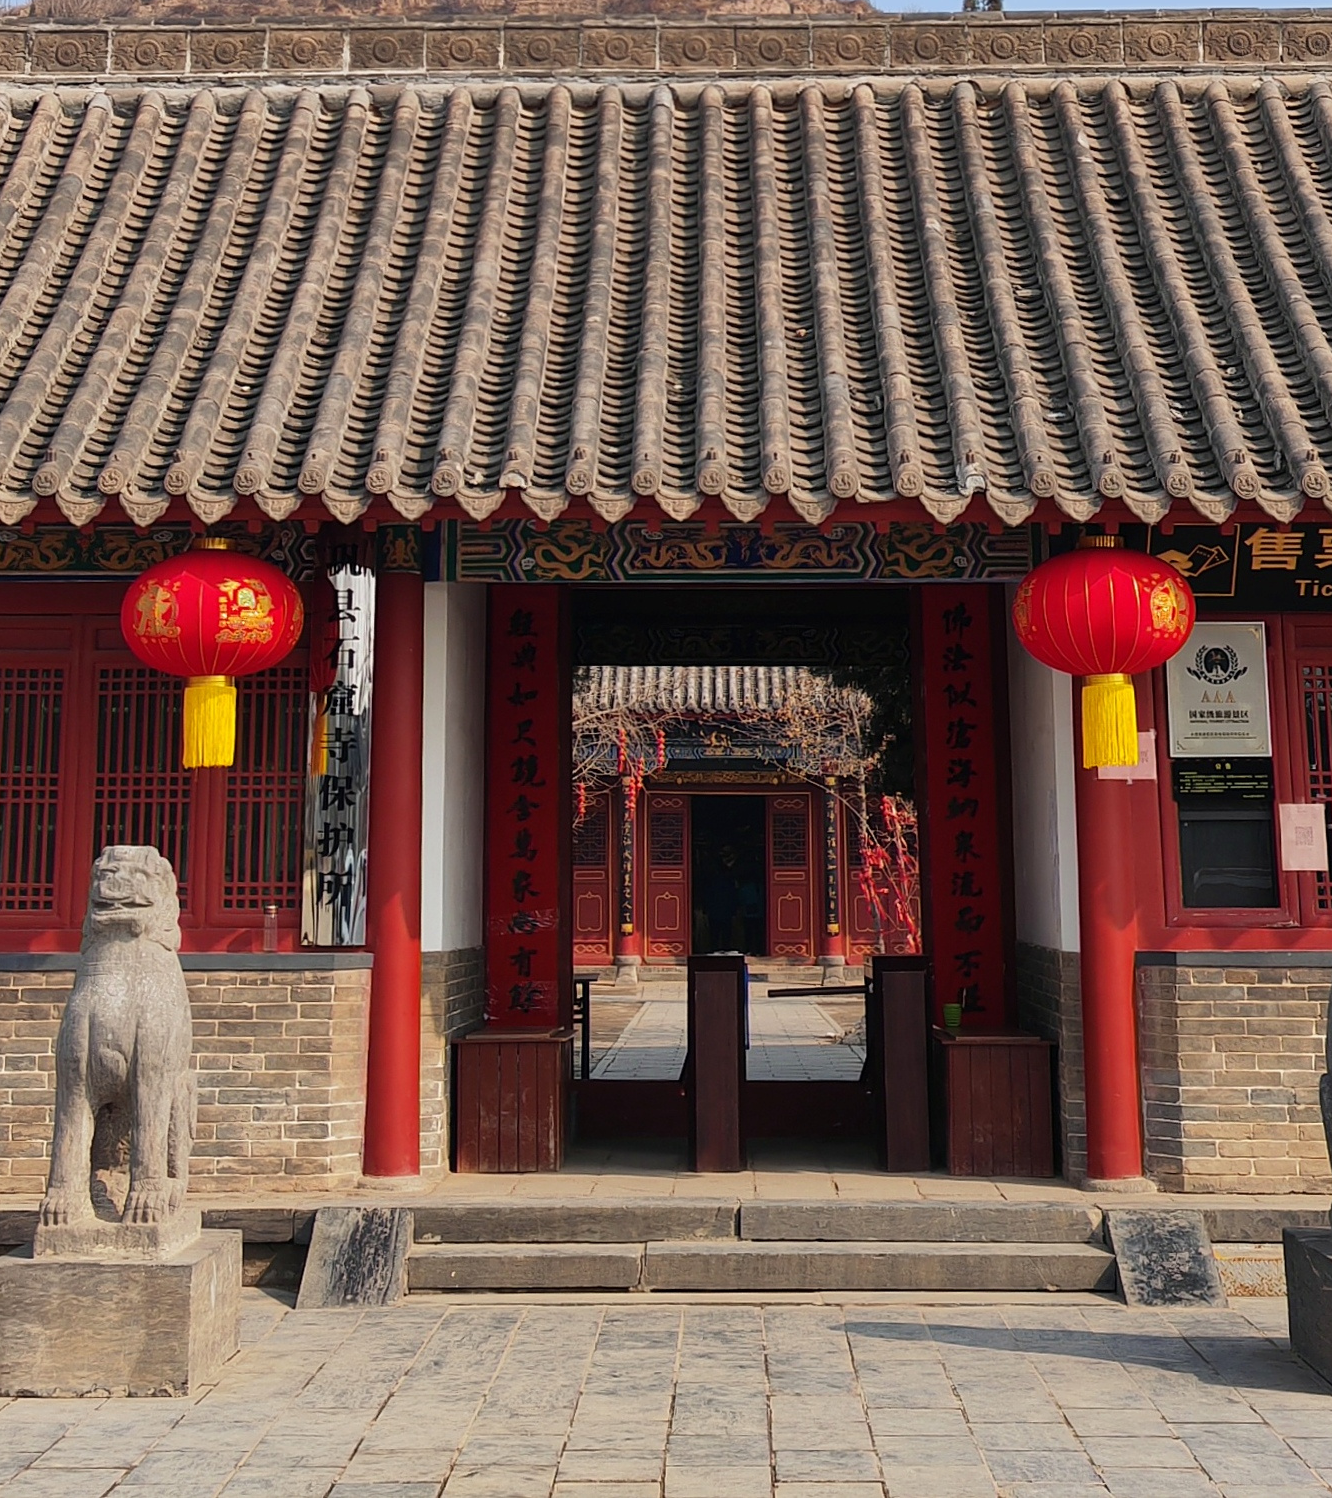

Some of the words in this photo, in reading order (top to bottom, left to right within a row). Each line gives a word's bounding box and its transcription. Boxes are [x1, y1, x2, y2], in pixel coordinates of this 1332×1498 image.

[316, 543, 361, 908] 巩县石窟寺保护所
